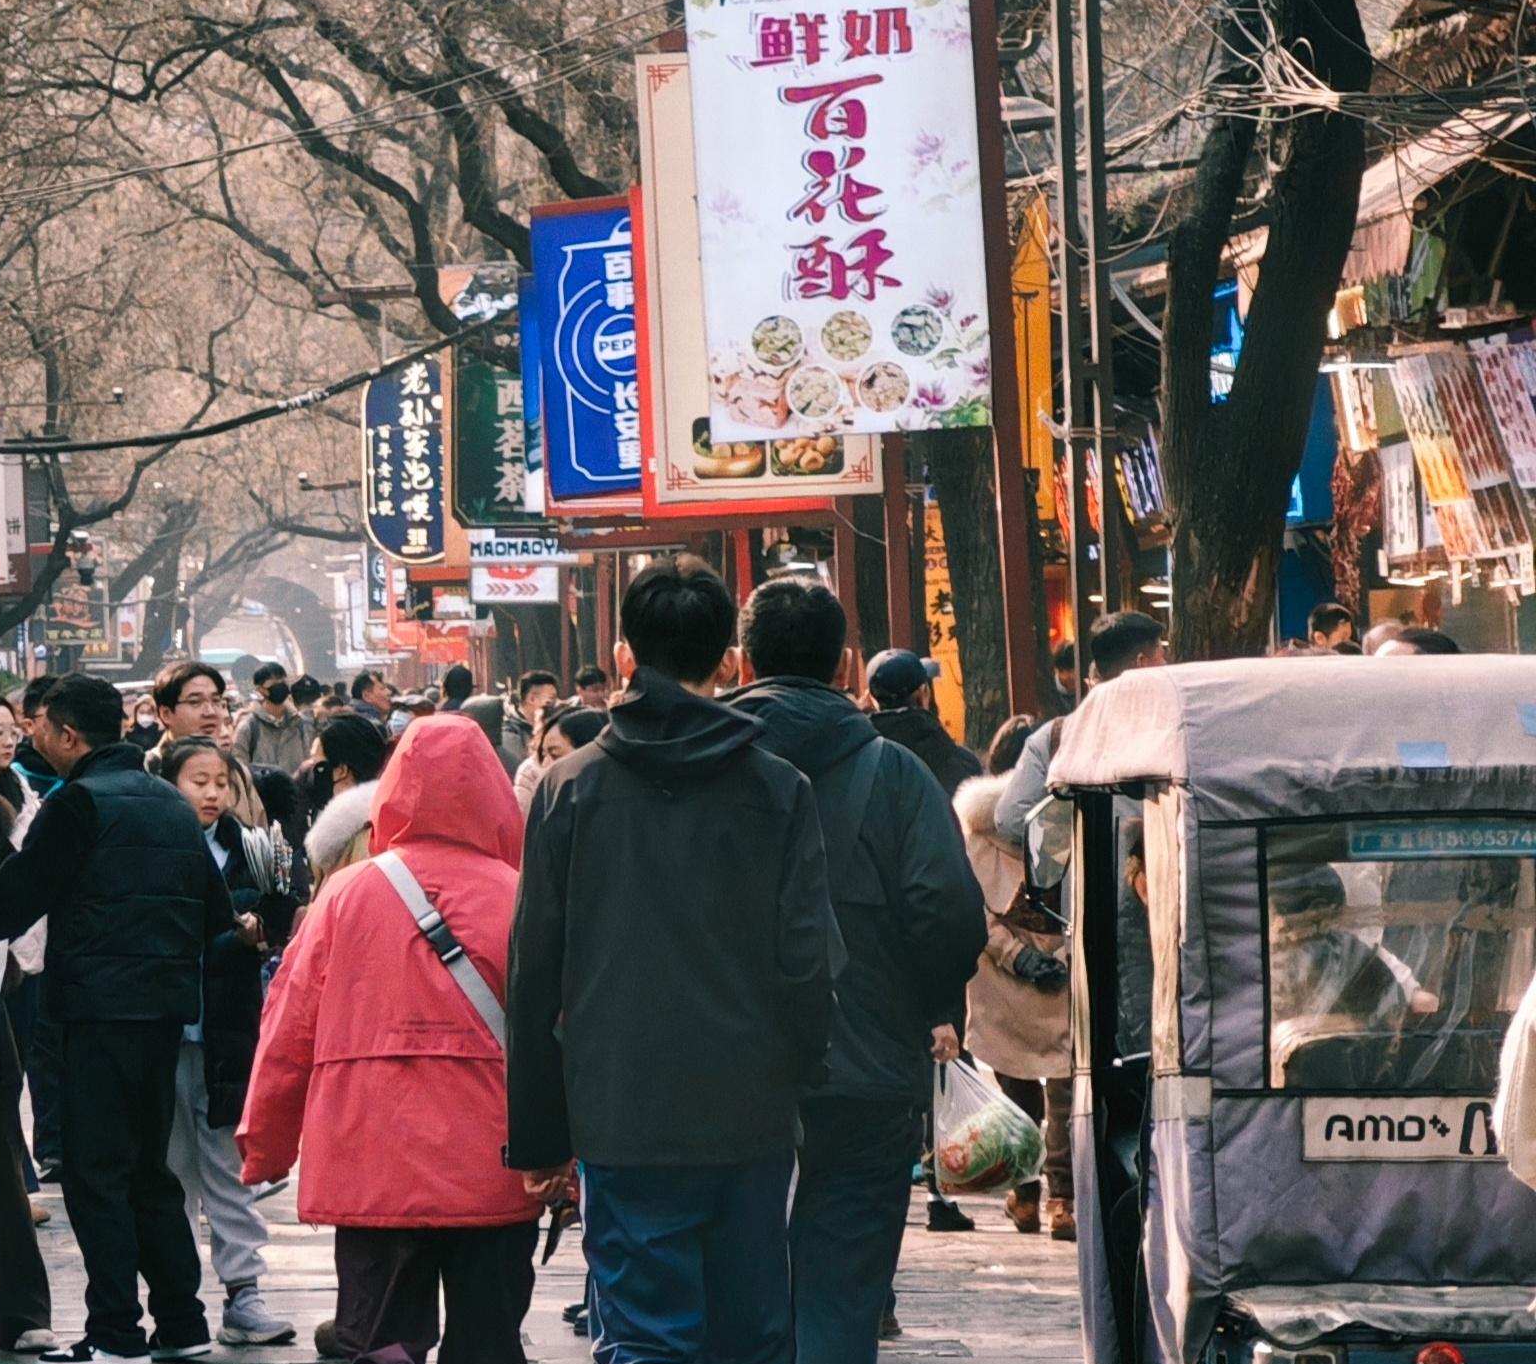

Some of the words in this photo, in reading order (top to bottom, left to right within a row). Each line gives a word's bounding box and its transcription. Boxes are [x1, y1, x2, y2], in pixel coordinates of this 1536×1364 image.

[748, 6, 914, 69] 鲜奶
[779, 73, 904, 302] 百花酥
[598, 338, 637, 353] PEP
